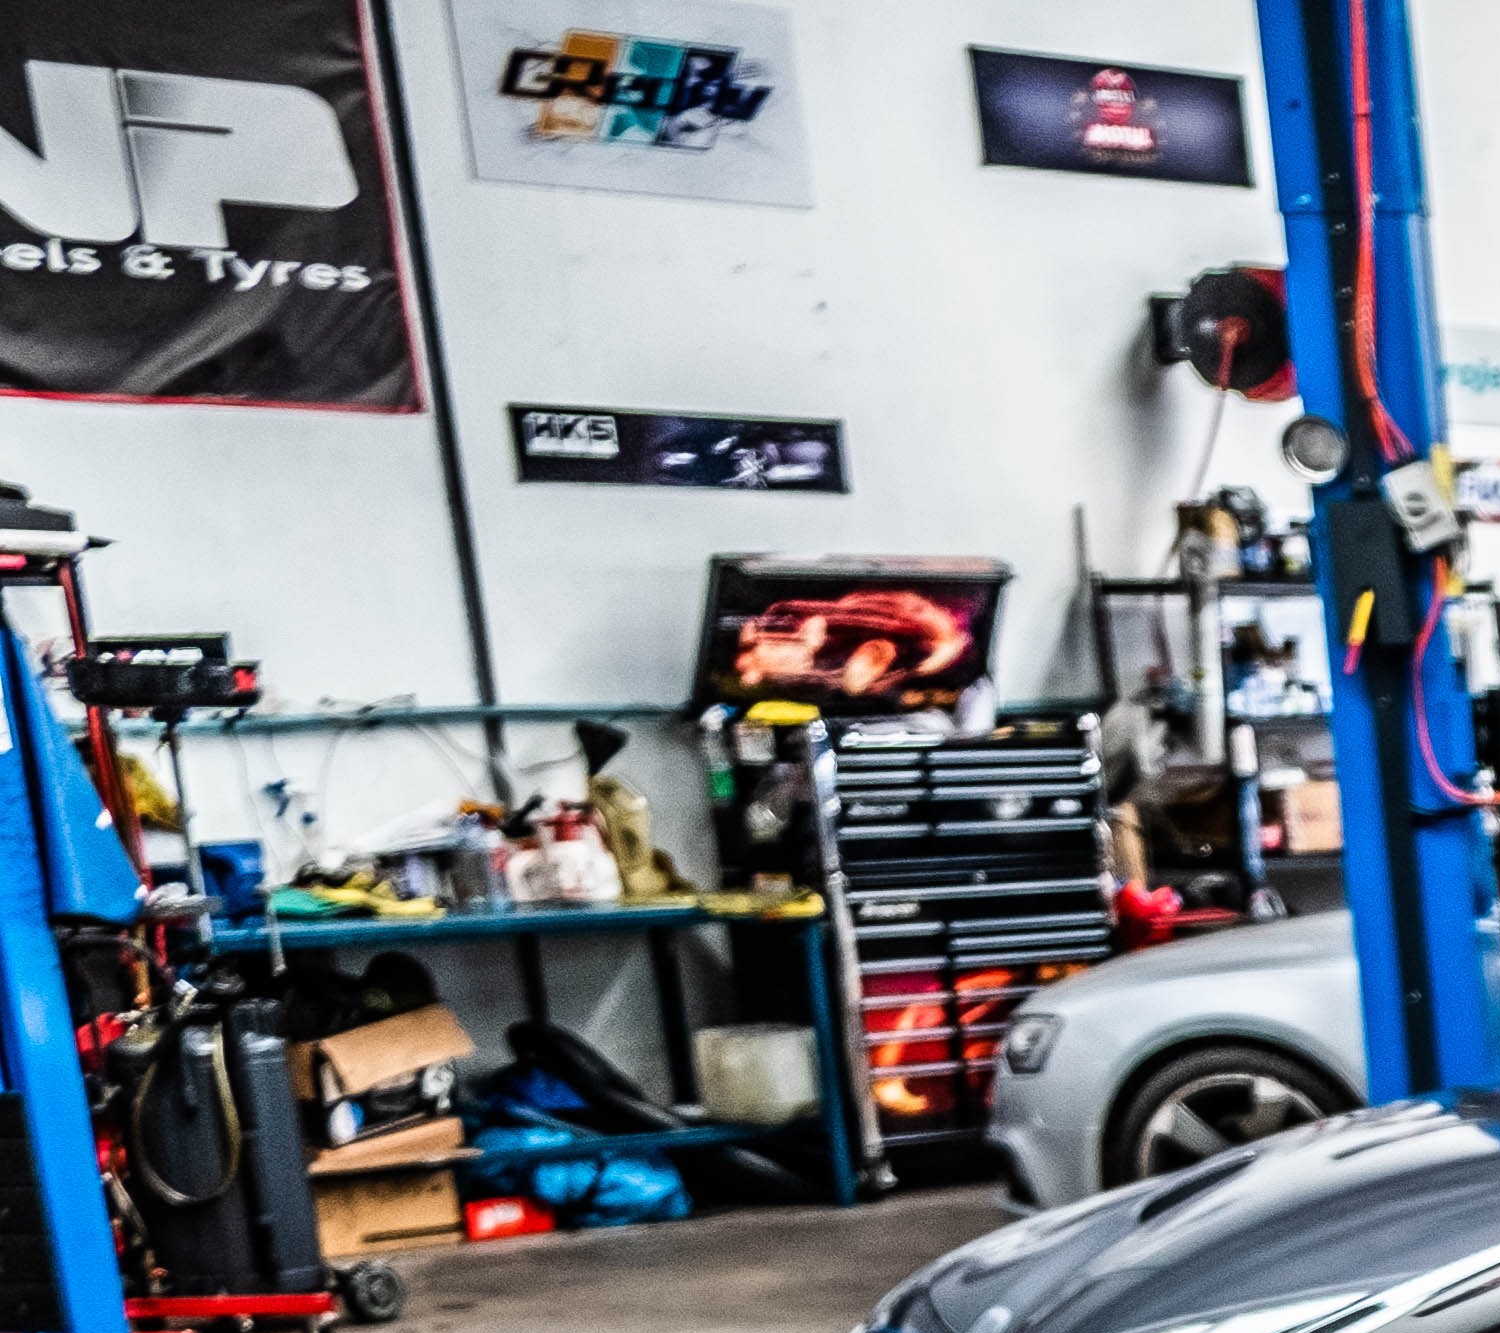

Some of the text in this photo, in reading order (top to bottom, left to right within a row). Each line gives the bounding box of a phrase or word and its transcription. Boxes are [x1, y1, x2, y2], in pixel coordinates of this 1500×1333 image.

[0, 238, 373, 292] els & Tyres
